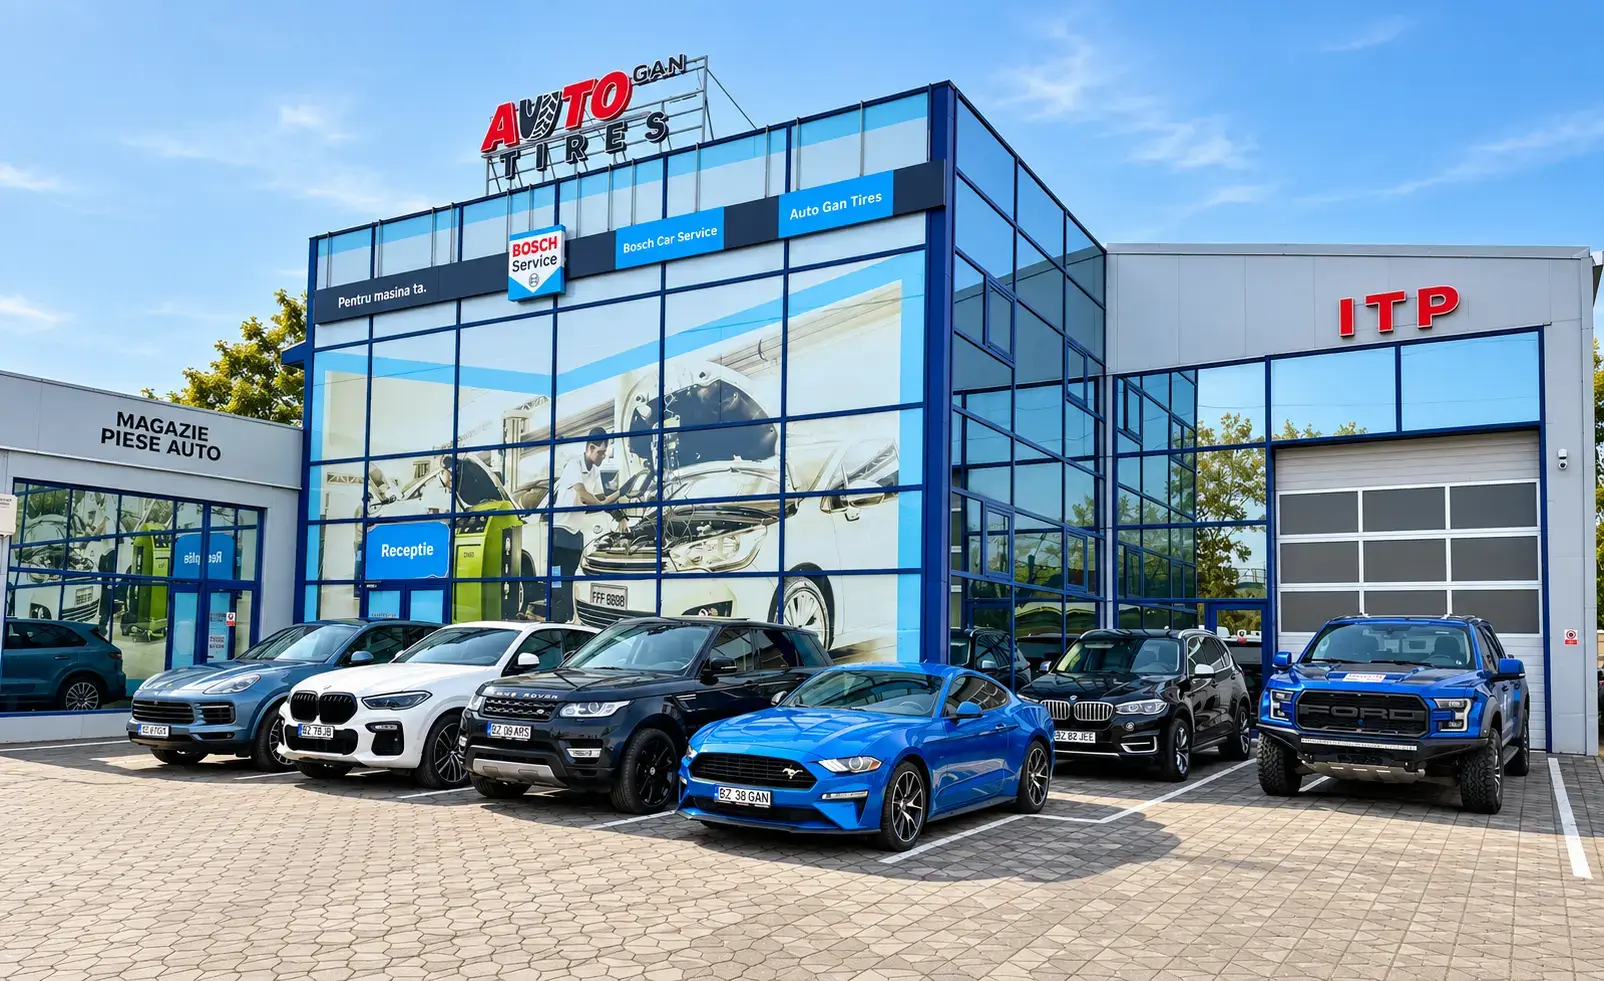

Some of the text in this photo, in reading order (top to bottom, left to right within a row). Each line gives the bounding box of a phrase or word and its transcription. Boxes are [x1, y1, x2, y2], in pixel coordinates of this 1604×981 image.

[480, 54, 687, 153] AUTO GAN
[500, 112, 669, 180] TIRES
[789, 192, 882, 220] Auto Gan Tires
[512, 235, 557, 257] BOSCH
[623, 227, 718, 254] Bosch Car Service
[512, 254, 558, 272] Service
[338, 283, 427, 309] Pentru masina ta.
[1339, 285, 1459, 337] ITP
[117, 411, 209, 442] MAGAZIE
[101, 428, 221, 461] PIESE AUTO
[381, 541, 434, 560] Receptie
[1299, 704, 1426, 721] FORD
[719, 788, 769, 803] BZ 38 GAN
